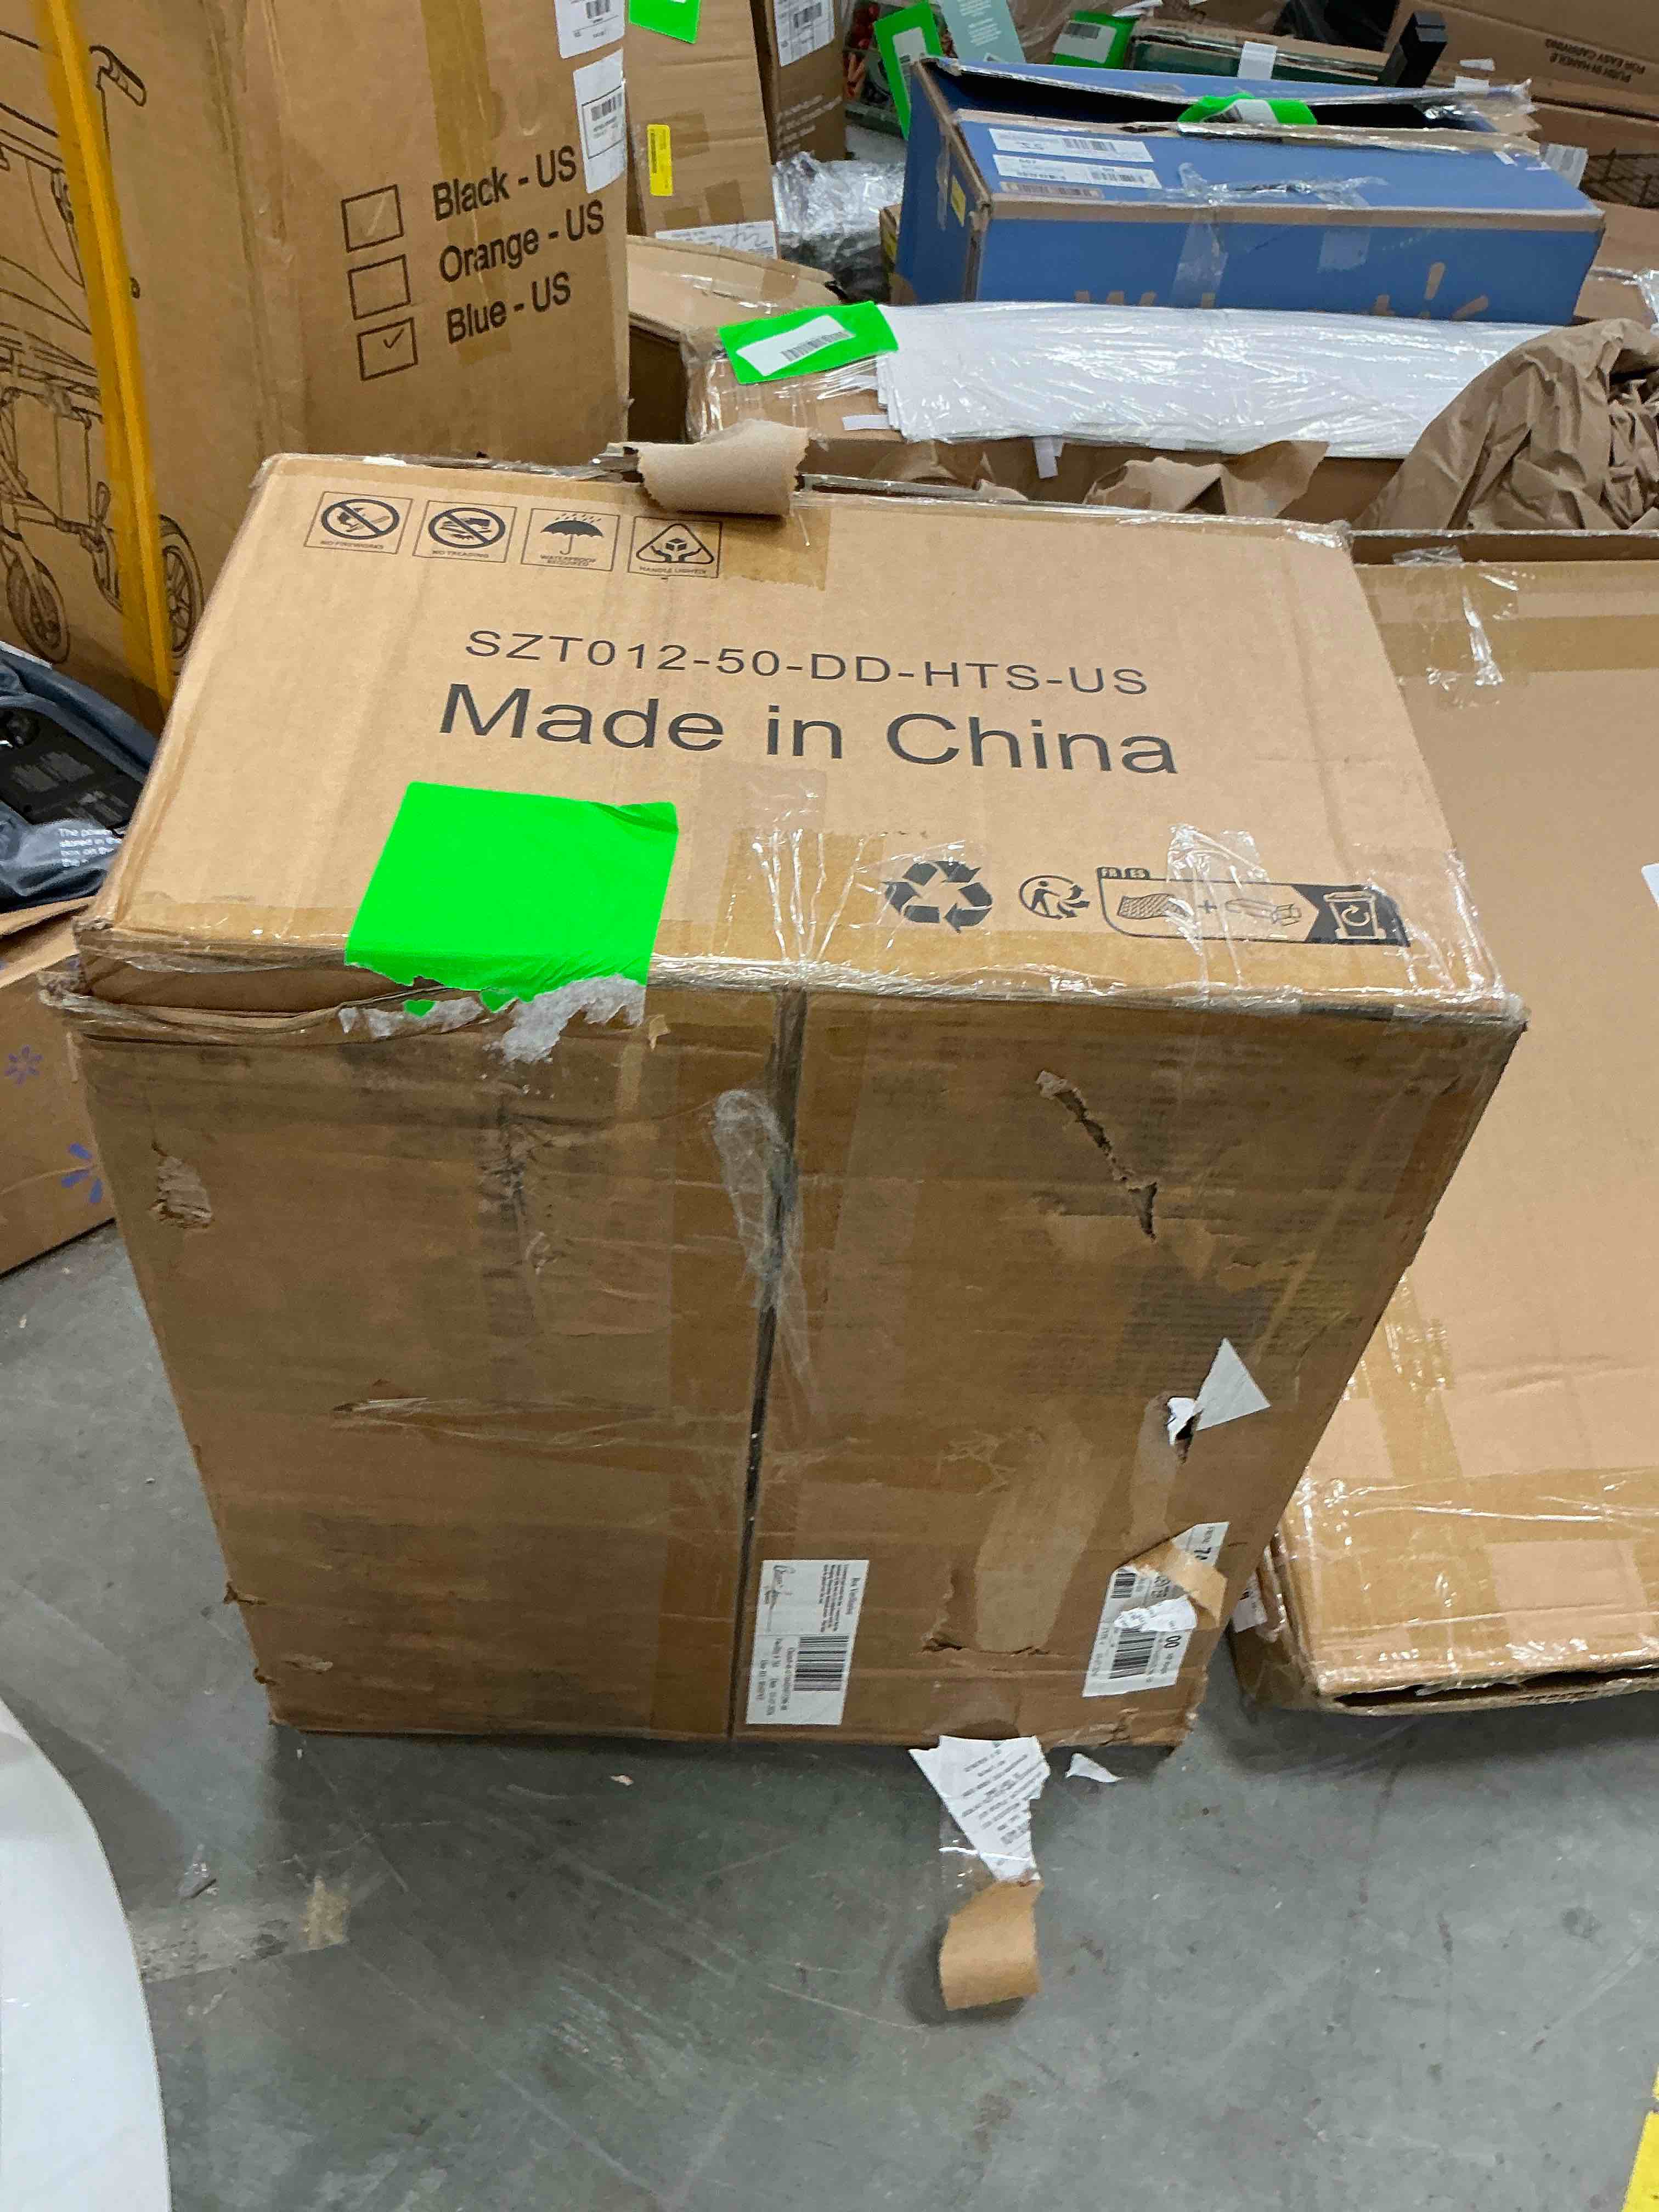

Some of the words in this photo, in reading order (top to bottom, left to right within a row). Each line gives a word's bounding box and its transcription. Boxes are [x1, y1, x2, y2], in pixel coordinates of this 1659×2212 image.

[432, 166, 510, 221] Black
[518, 176, 529, 186] -
[535, 145, 577, 188] US
[439, 228, 539, 283] Orange
[548, 230, 559, 239] -
[566, 199, 604, 241] US
[447, 300, 507, 345] Blue
[514, 303, 524, 312] -
[531, 271, 571, 312] US
[465, 630, 1147, 695] SZT012-50-DD-HTS-US
[439, 683, 724, 752] Made
[767, 704, 843, 759] in
[887, 713, 1178, 775] China
